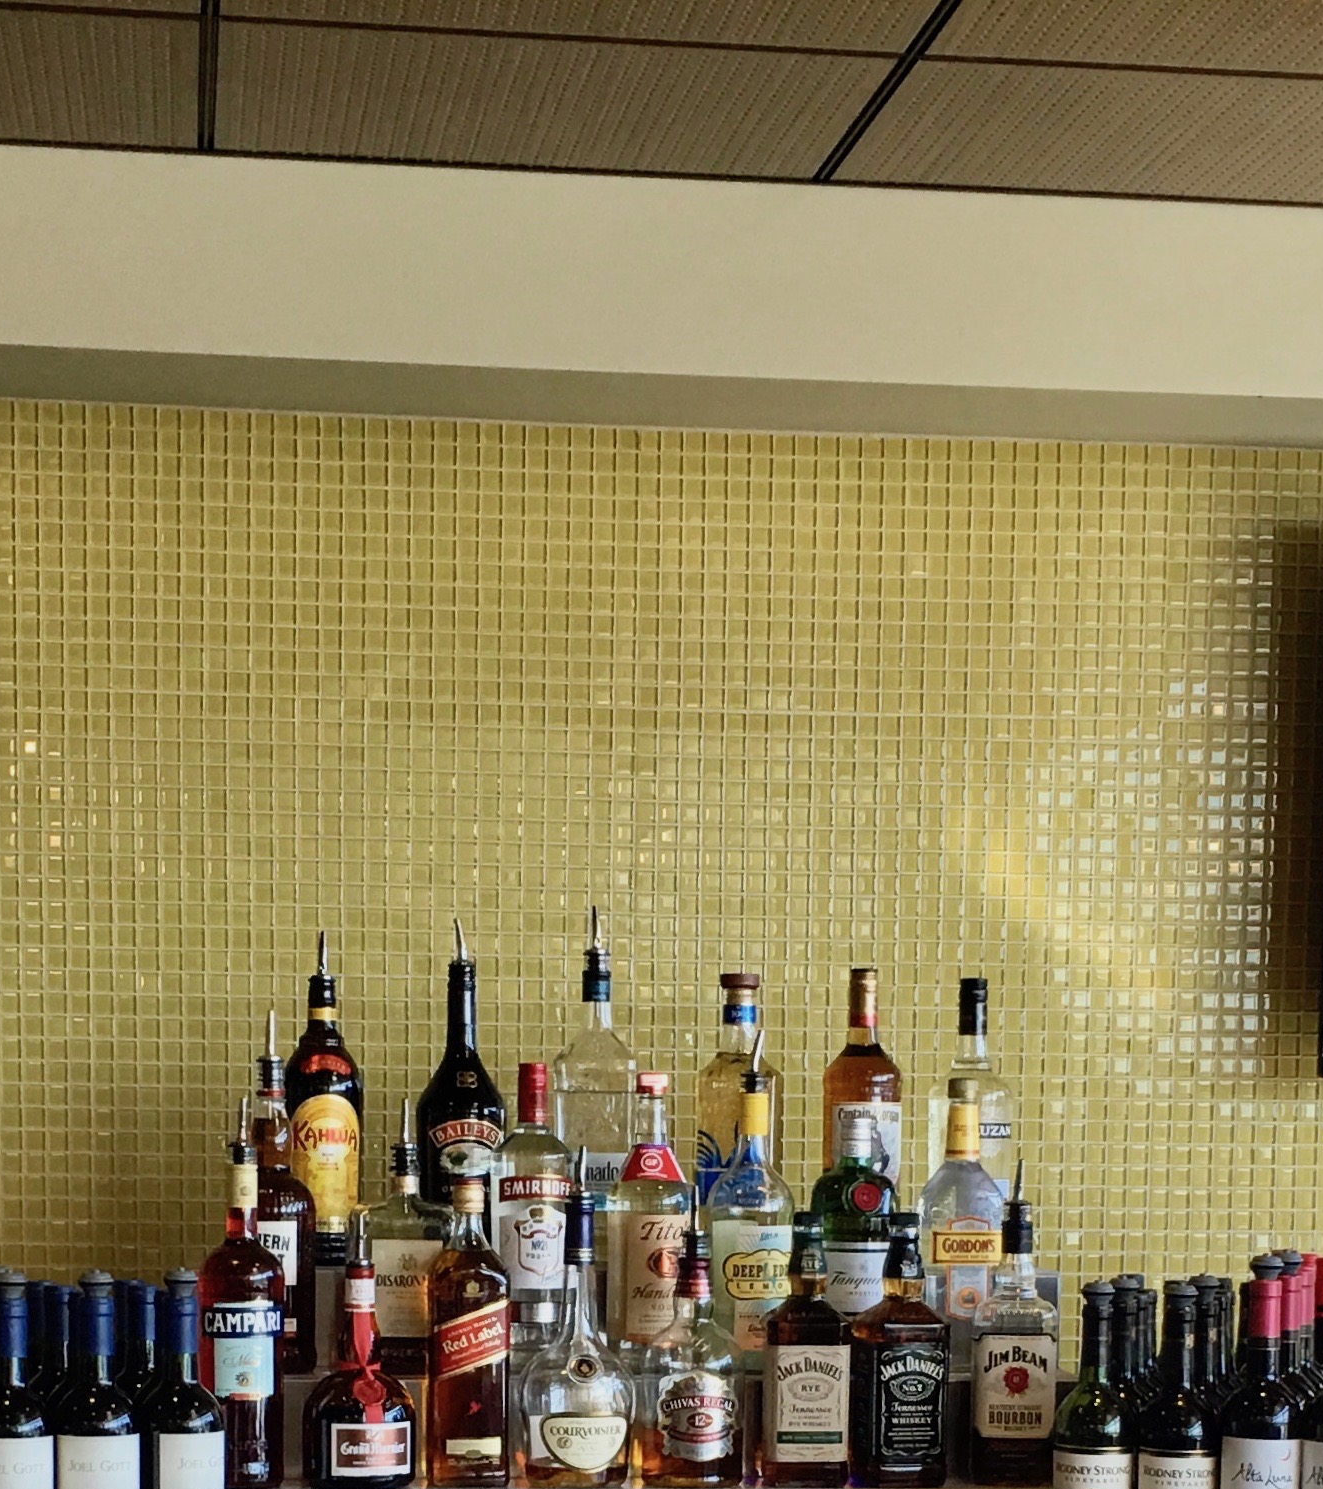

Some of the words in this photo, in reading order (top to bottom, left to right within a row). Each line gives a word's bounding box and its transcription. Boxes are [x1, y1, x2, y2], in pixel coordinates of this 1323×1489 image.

[837, 1106, 871, 1121] Captain
[435, 1125, 498, 1145] BAILEYS
[979, 1125, 1011, 1137] UZAN
[503, 1179, 572, 1197] SMIRNOFF
[942, 1237, 996, 1254] GORDON'S
[732, 1264, 764, 1278] DEEP
[204, 1310, 282, 1334] CAMPARI
[441, 1335, 470, 1355] Red
[983, 1350, 1010, 1374] JIM
[1011, 1345, 1048, 1374] BEAM
[777, 1361, 803, 1382] JACK
[803, 1356, 844, 1382] DANIEL'S
[880, 1360, 906, 1382] JACK
[905, 1355, 945, 1381] DANIEL'S
[800, 1385, 821, 1393] RYE
[662, 1398, 702, 1413] CHIVAS
[703, 1397, 734, 1412] REGAL
[789, 1403, 833, 1414] Tennessee
[891, 1401, 934, 1412] Tennessee
[693, 1414, 706, 1426] 12
[891, 1416, 933, 1425] WHISKEY
[988, 1410, 1043, 1425] BOURBON
[549, 1425, 622, 1440] COURVOISIER
[339, 1440, 370, 1456] Grand
[13, 1462, 46, 1475] GOTT
[99, 1459, 132, 1473] GOTT
[177, 1457, 205, 1471] JOEL
[1055, 1461, 1092, 1475] RODNEY
[1093, 1464, 1131, 1476] STRONG
[1143, 1465, 1184, 1479] RODNEY
[1231, 1462, 1264, 1483] Alta
